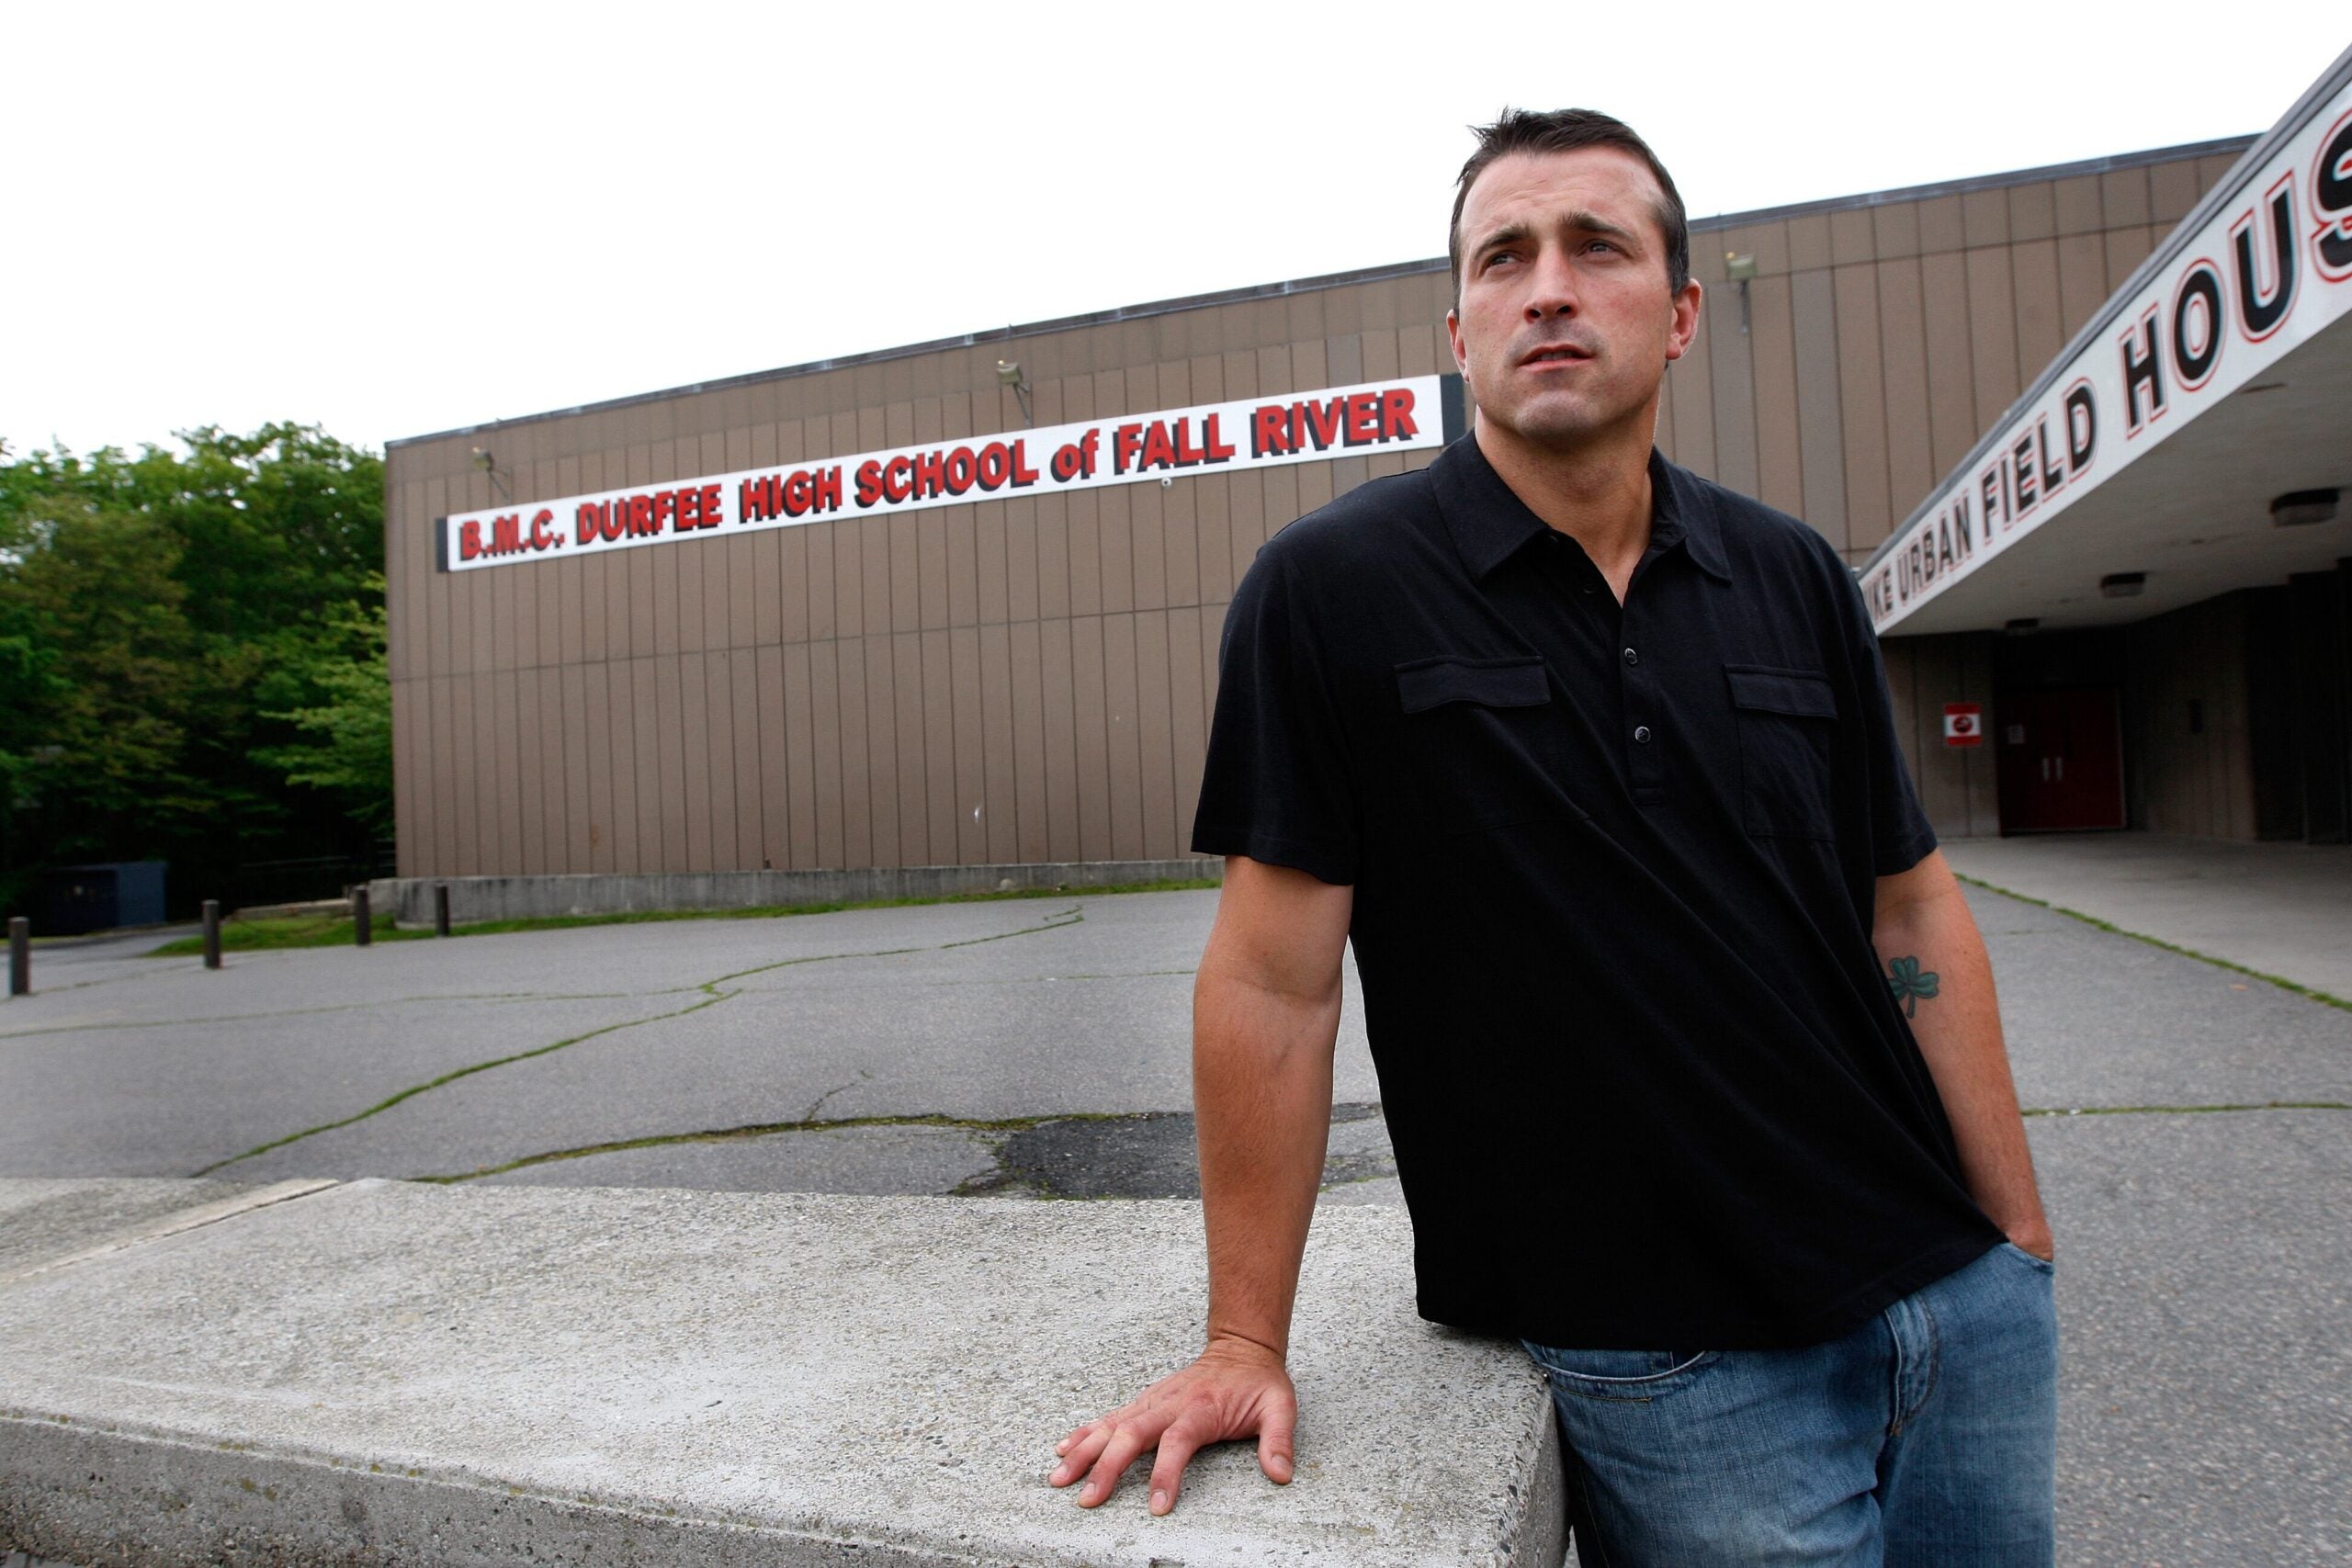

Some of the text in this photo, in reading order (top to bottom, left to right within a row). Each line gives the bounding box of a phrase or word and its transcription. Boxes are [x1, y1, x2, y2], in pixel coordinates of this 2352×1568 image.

[459, 387, 1420, 561] B.M.C. DURFEE HIGH SCHOOL of FALL RIVER
[1896, 487, 1974, 608] URBAN
[1979, 377, 2100, 545] FIELD
